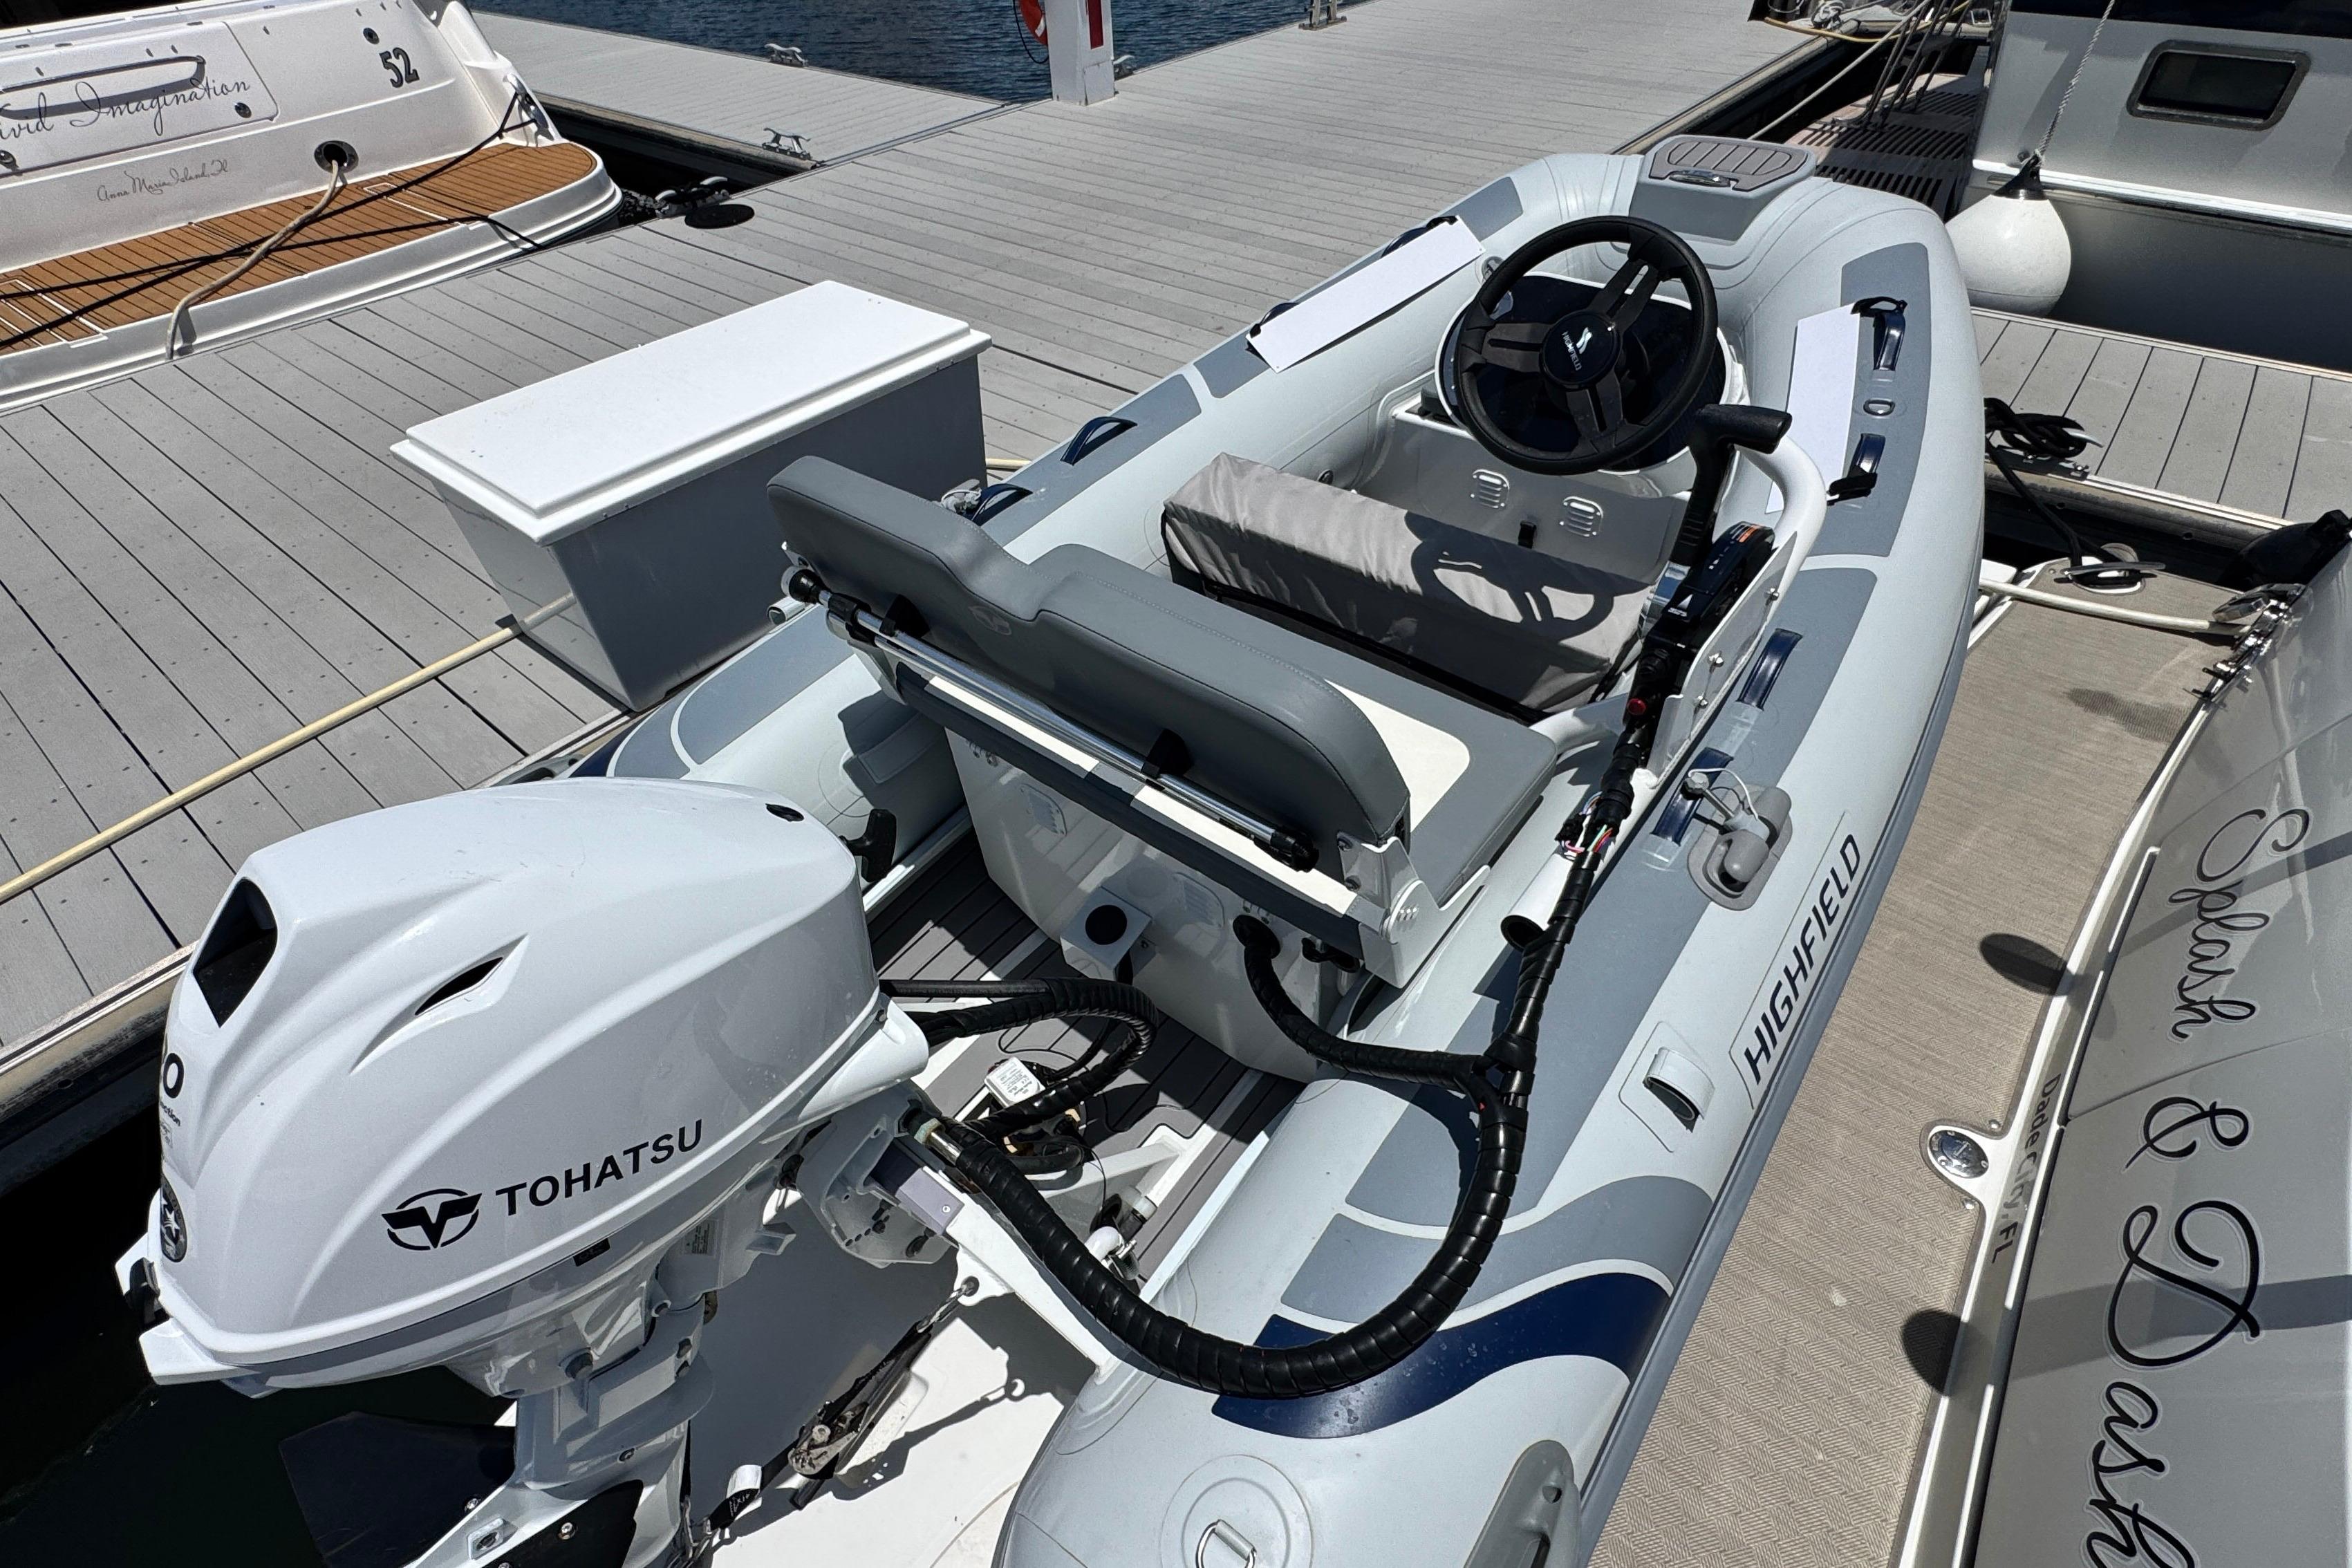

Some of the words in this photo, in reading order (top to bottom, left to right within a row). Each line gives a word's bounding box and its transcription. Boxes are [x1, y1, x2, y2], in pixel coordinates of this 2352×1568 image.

[379, 47, 420, 88] 52
[0, 92, 54, 140] ivid
[70, 81, 250, 136] Imagination
[97, 185, 129, 202] Anna
[124, 170, 171, 195] Maria
[1744, 834, 1860, 1085] HIGHFIELD
[2168, 808, 2310, 1038] Splash
[161, 1045, 185, 1099] 0
[2024, 1073, 2061, 1150] Dade
[2125, 1096, 2250, 1170] &
[495, 1119, 702, 1216] TOHATSU
[1992, 1221, 2018, 1264] FL
[2086, 1200, 2261, 1568] Dash
